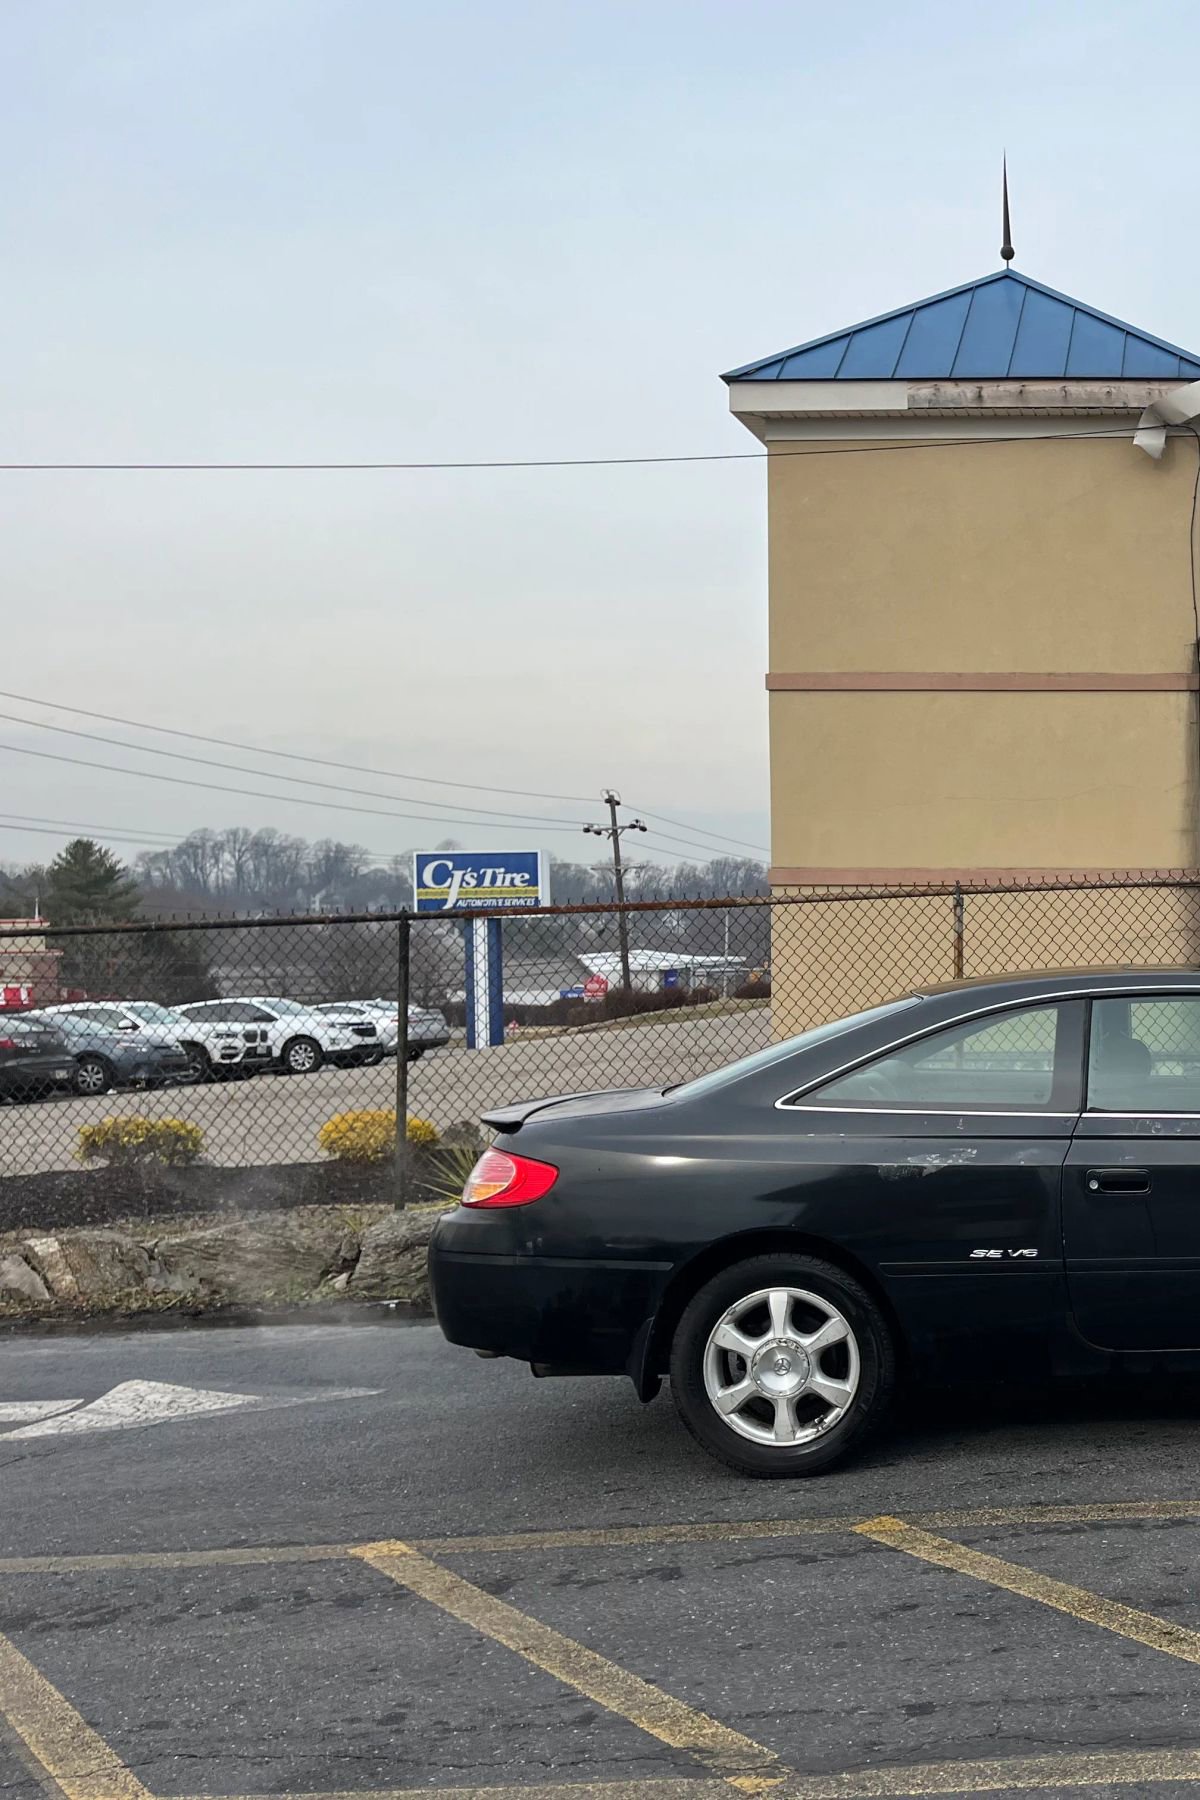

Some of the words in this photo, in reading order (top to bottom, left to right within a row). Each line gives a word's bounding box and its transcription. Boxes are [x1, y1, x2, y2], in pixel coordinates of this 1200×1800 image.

[422, 860, 477, 910] CJ's
[480, 867, 530, 887] Tire
[457, 898, 502, 907] AUTOMOTIVE
[504, 897, 535, 906] SERVICES
[969, 1249, 1004, 1258] SE
[1007, 1248, 1038, 1257] V6
